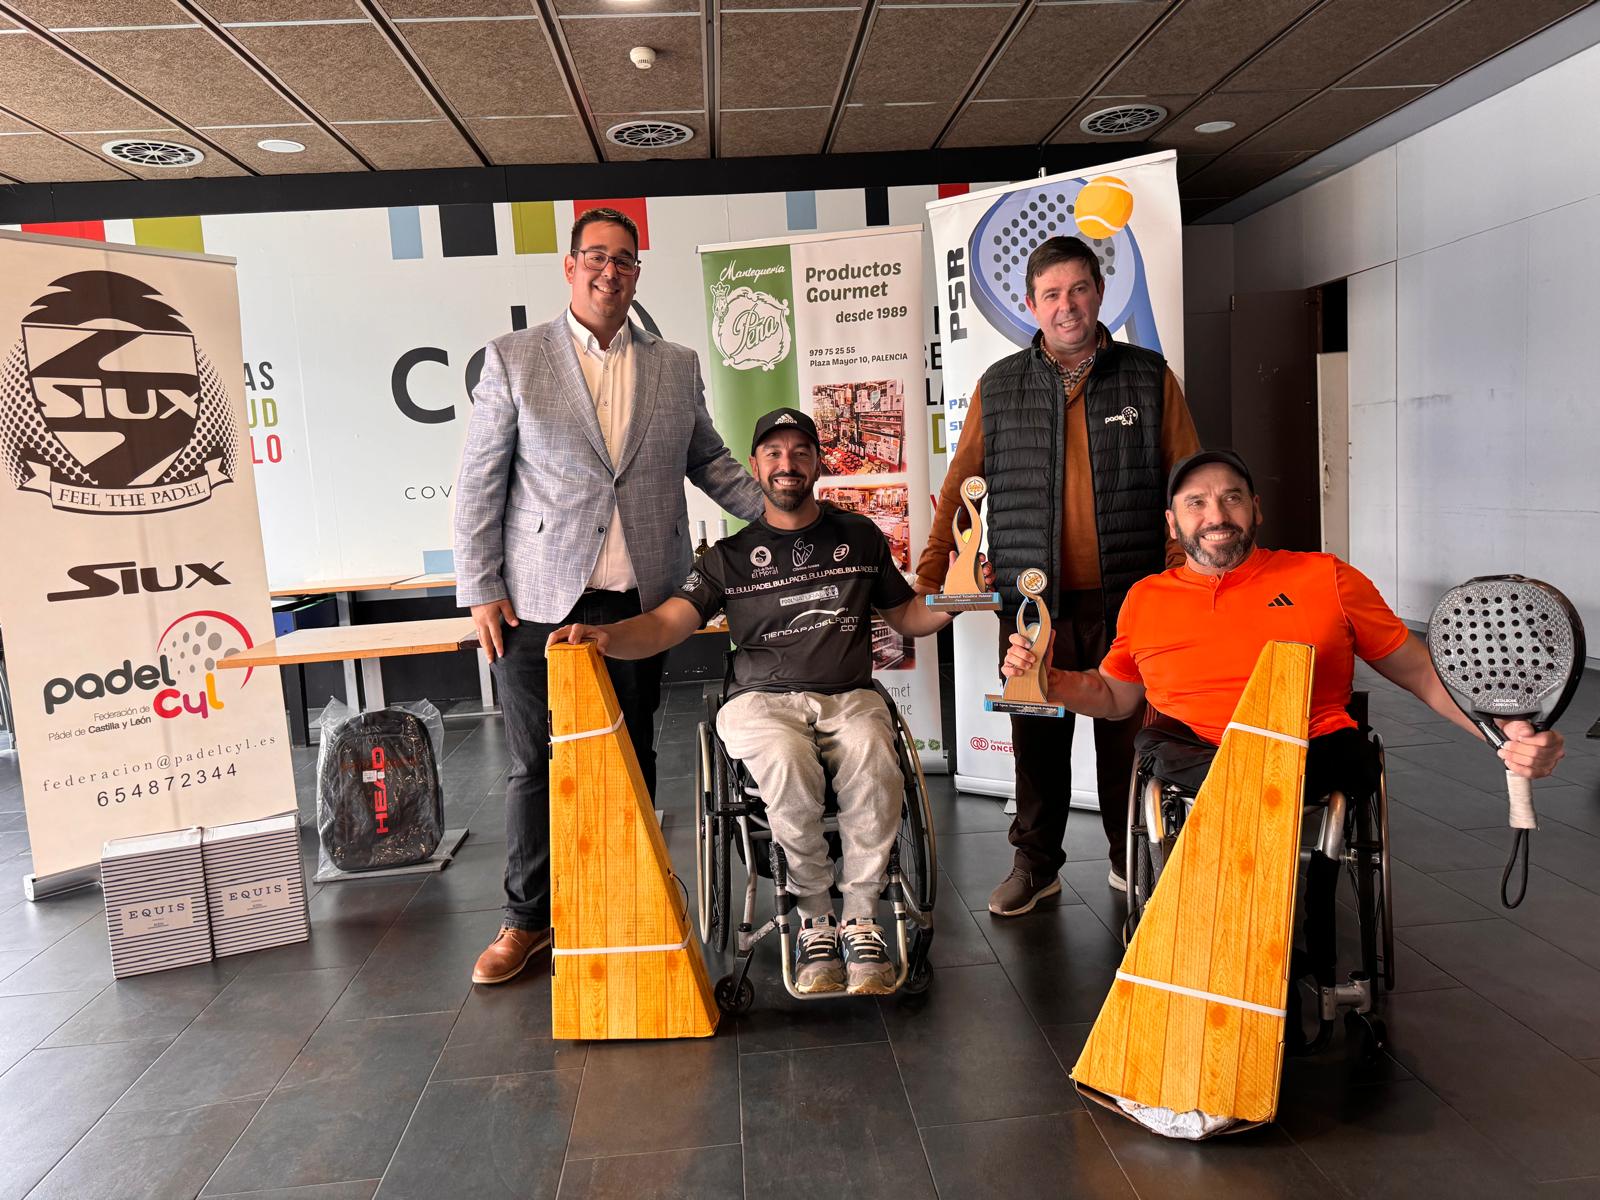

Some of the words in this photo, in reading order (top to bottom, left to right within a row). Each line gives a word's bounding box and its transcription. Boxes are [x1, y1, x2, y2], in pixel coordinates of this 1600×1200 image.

[805, 261, 902, 283] Productos
[806, 281, 889, 303] Gourmet
[947, 247, 968, 344] PSR
[835, 308, 874, 324] desde
[877, 305, 908, 319] 1989
[810, 359, 831, 367] Plaza
[832, 357, 858, 366] Mayor
[859, 356, 870, 364] 10,
[871, 353, 908, 362] PALENCIA
[846, 346, 856, 354] 55
[31, 376, 201, 420] SIUX
[57, 488, 101, 507] FEEL
[105, 492, 147, 507] THE
[151, 483, 207, 505] PADEL
[47, 561, 232, 602] SIUX
[43, 654, 176, 715] padel
[94, 707, 138, 721] Federación
[140, 705, 150, 713] de
[48, 729, 73, 741] Pádel
[74, 728, 86, 737] de
[88, 721, 120, 733] Castilla
[122, 721, 128, 729] y
[130, 716, 151, 726] León
[990, 744, 1014, 753] ONCE
[43, 735, 277, 792] federacion@padelcyl.es
[97, 763, 237, 807] 654872344
[229, 884, 283, 901] EQUIS
[129, 903, 185, 919] EQUIS
